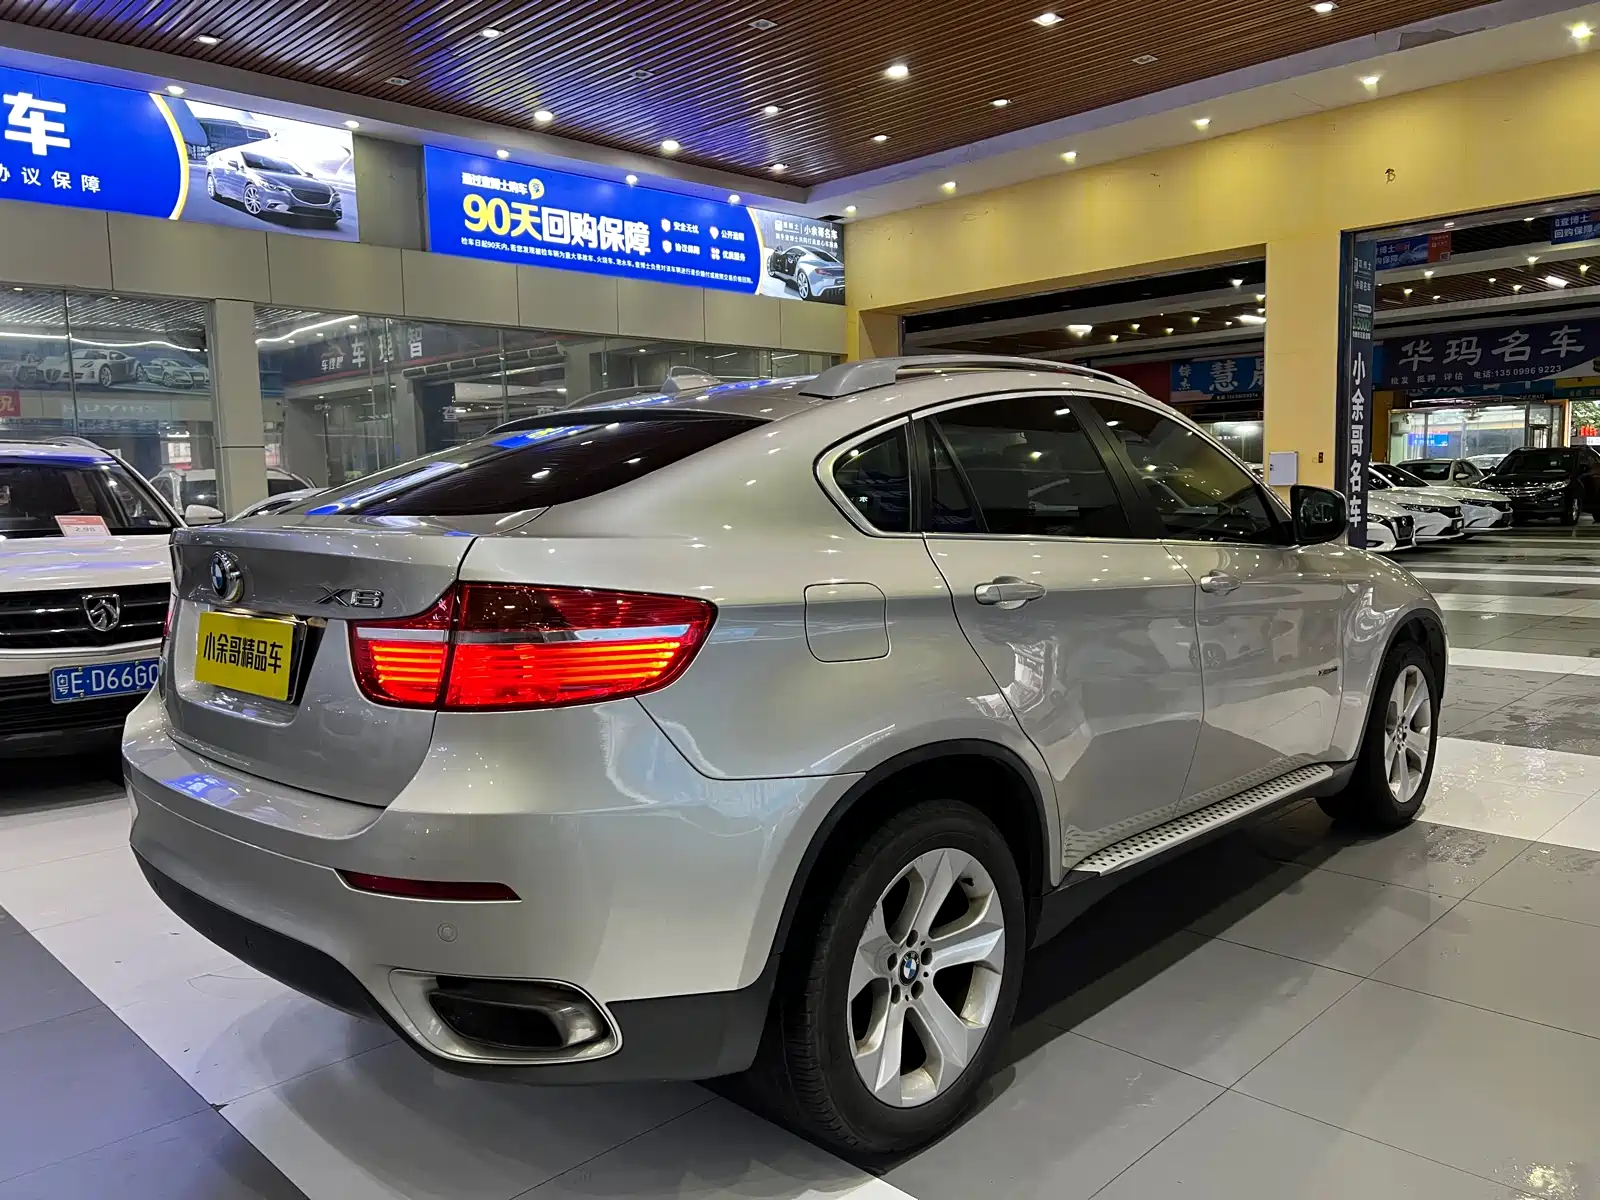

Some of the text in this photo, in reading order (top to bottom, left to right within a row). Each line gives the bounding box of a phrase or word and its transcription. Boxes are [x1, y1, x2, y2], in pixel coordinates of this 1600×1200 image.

[2, 92, 71, 156] 车
[462, 193, 651, 256] 90天回购保障
[1376, 244, 1396, 255] 博士
[1398, 325, 1586, 373] 华玛名车
[1513, 366, 1536, 376] 0996
[1538, 364, 1562, 374] 9223
[1350, 352, 1366, 528] 小余哥名车
[203, 632, 284, 674] 小余哥精品车
